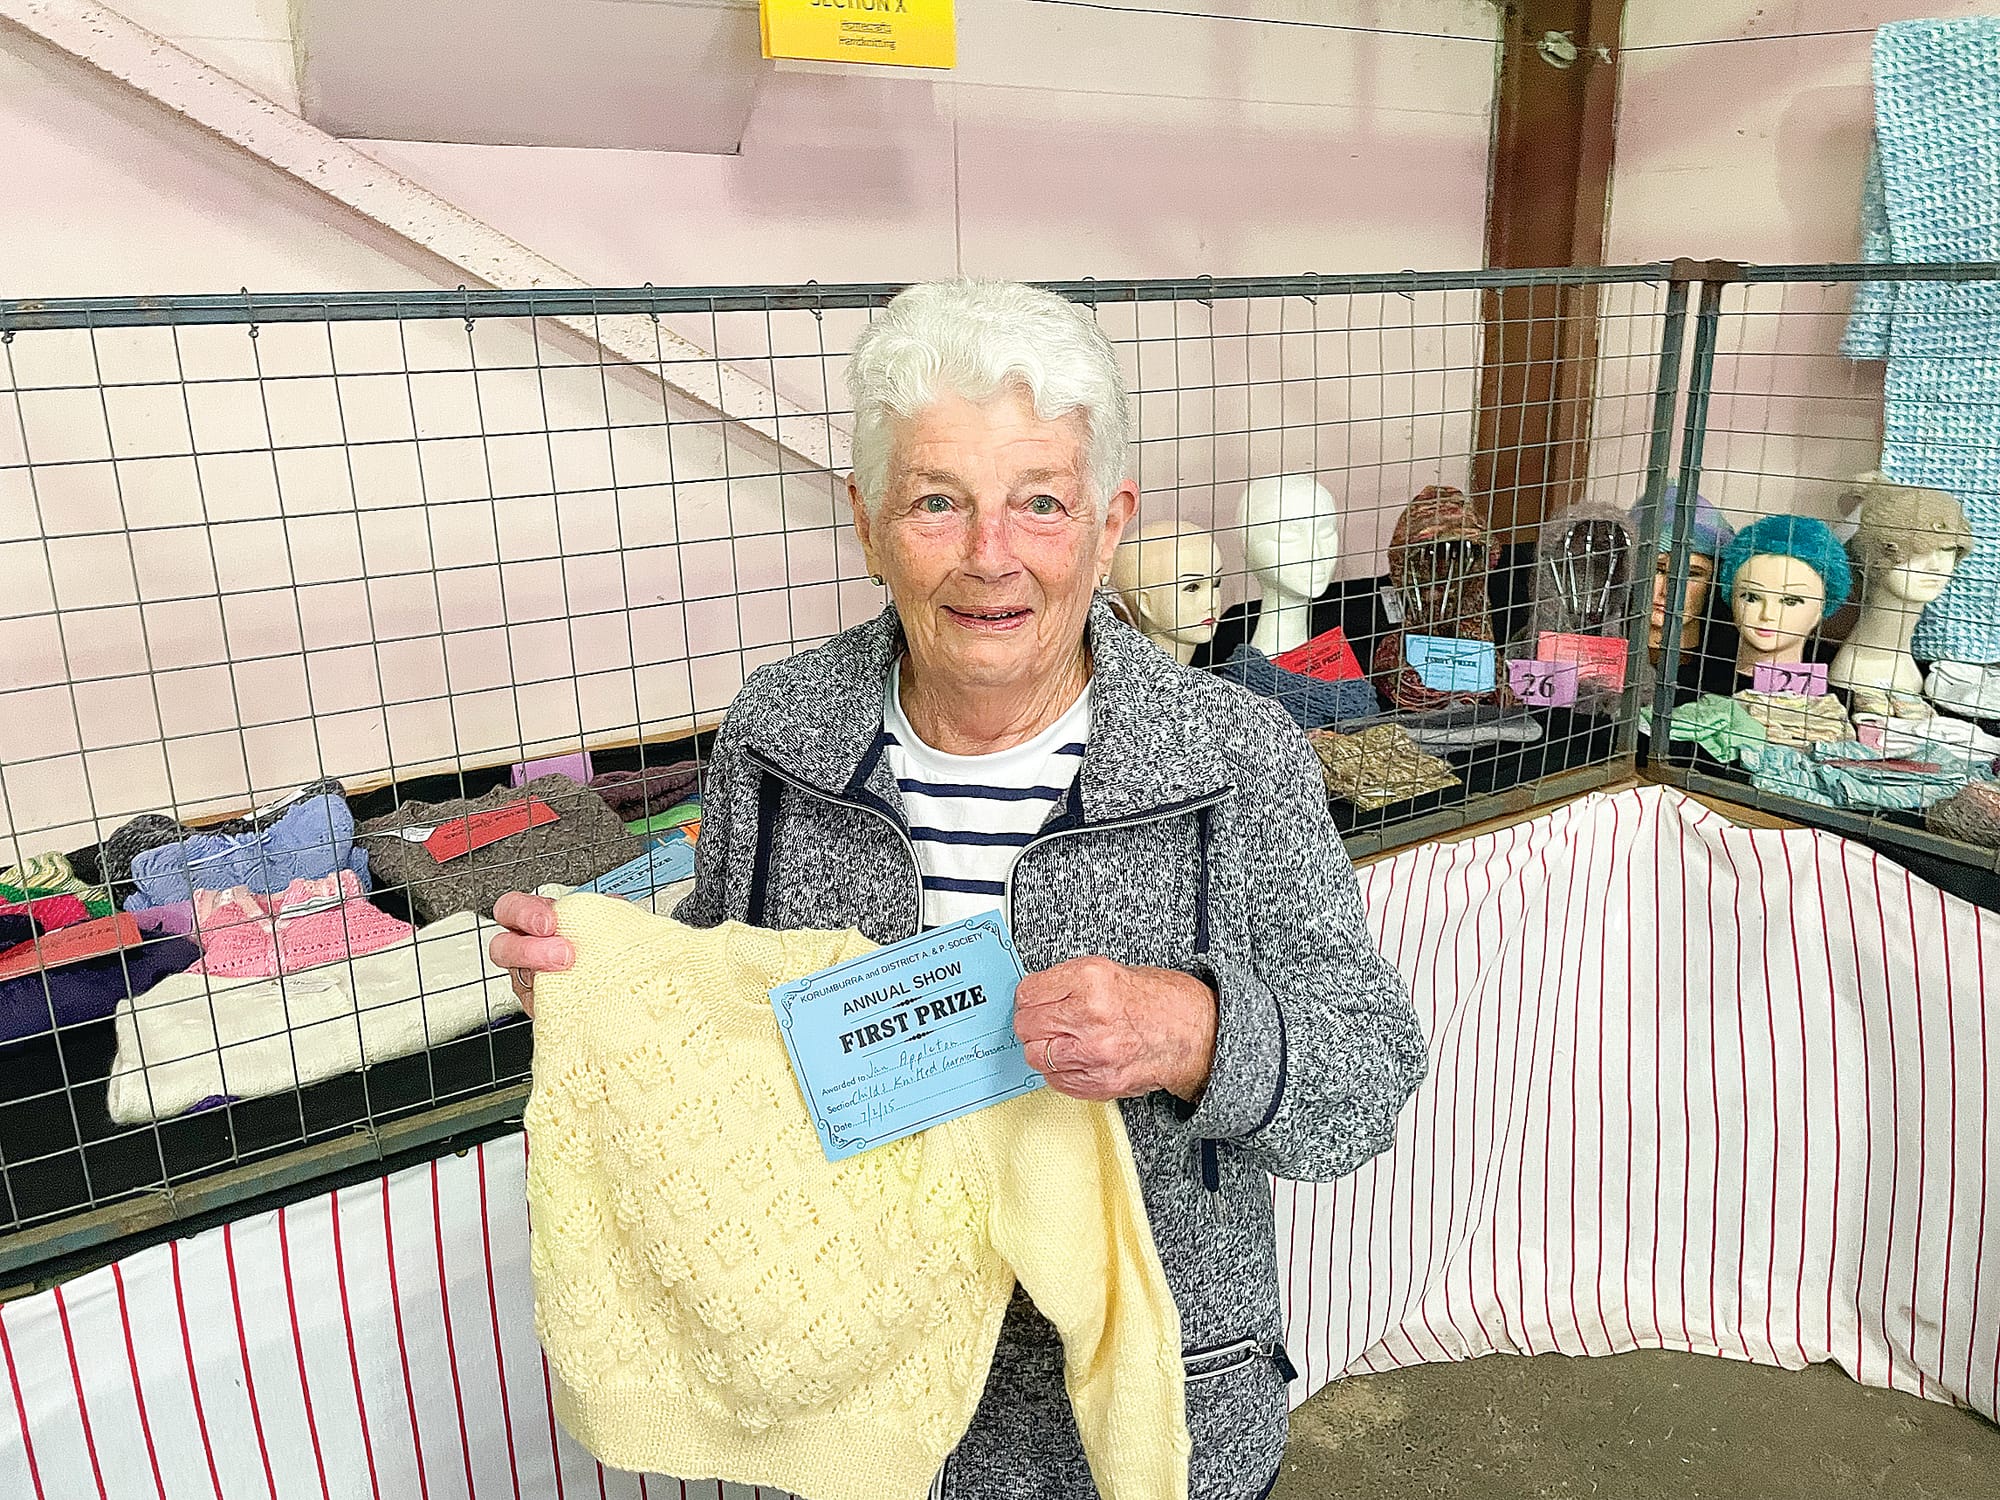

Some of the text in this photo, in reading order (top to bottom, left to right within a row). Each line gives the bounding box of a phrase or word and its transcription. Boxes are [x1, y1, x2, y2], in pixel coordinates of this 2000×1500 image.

[1520, 673, 1556, 698] 26
[1778, 671, 1812, 694] 27
[800, 974, 865, 1004] KORUMBURRA
[865, 967, 881, 980] and
[881, 952, 920, 974] DISTRICT
[931, 947, 938, 956] &
[947, 931, 983, 950] SOCIETY
[842, 960, 962, 1017] ANNUAL SHOW
[838, 984, 988, 1054] FIRST PRIZE
[821, 1076, 857, 1096] Awarded
[826, 1099, 855, 1115] Section
[833, 1121, 853, 1134] Date
